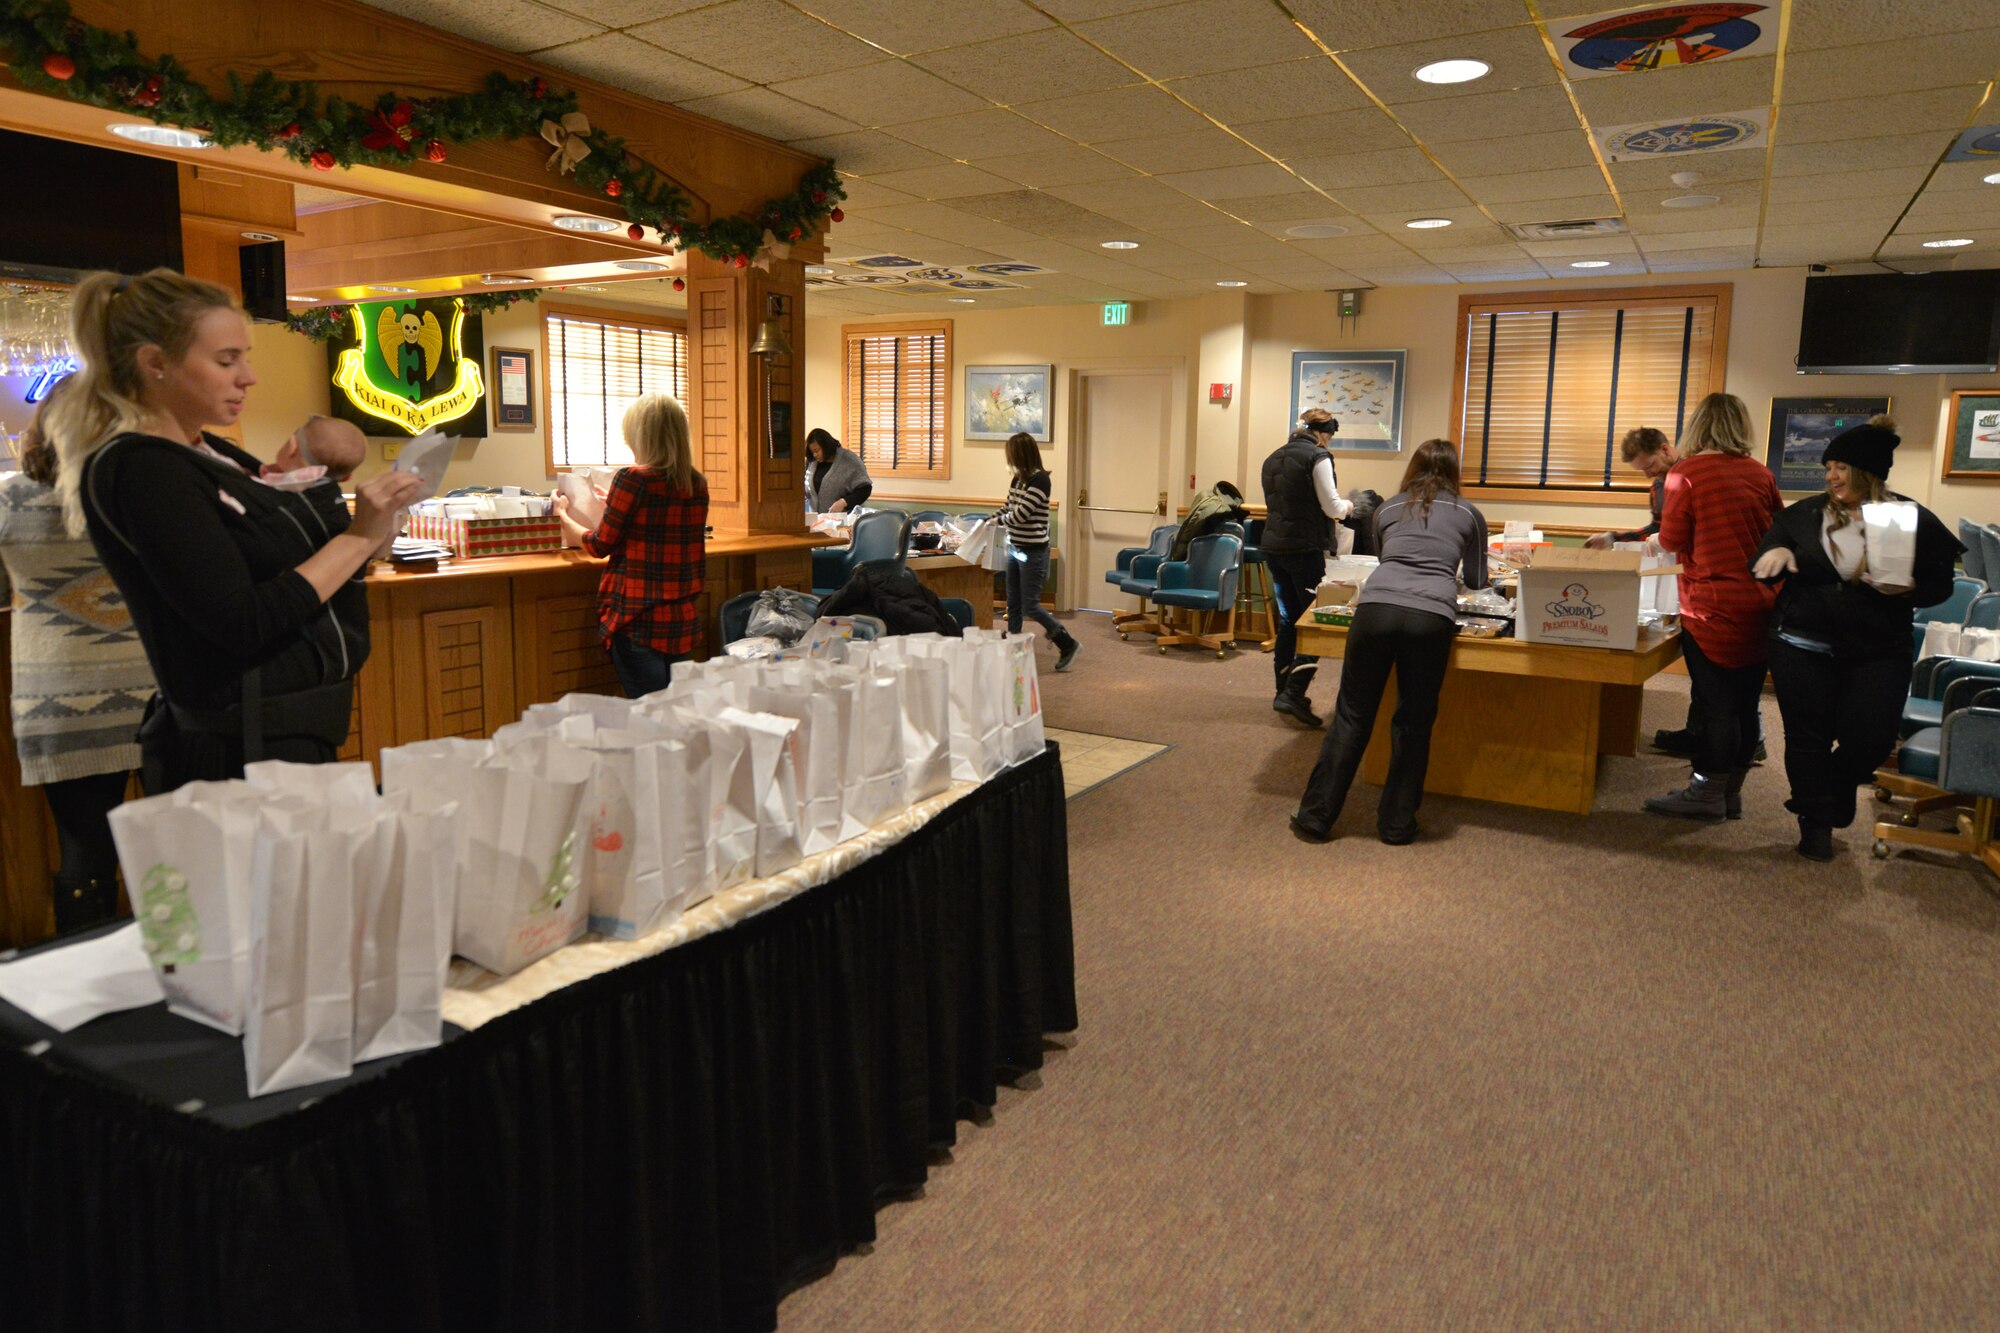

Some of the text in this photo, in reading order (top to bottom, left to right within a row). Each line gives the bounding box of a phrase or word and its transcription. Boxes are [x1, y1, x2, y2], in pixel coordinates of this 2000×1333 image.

[1104, 303, 1128, 325] EXIT
[354, 382, 468, 427] KIAI O KA LEWA
[1553, 602, 1597, 620] SNOBOY
[1542, 618, 1608, 636] PREMIUM SALADS
